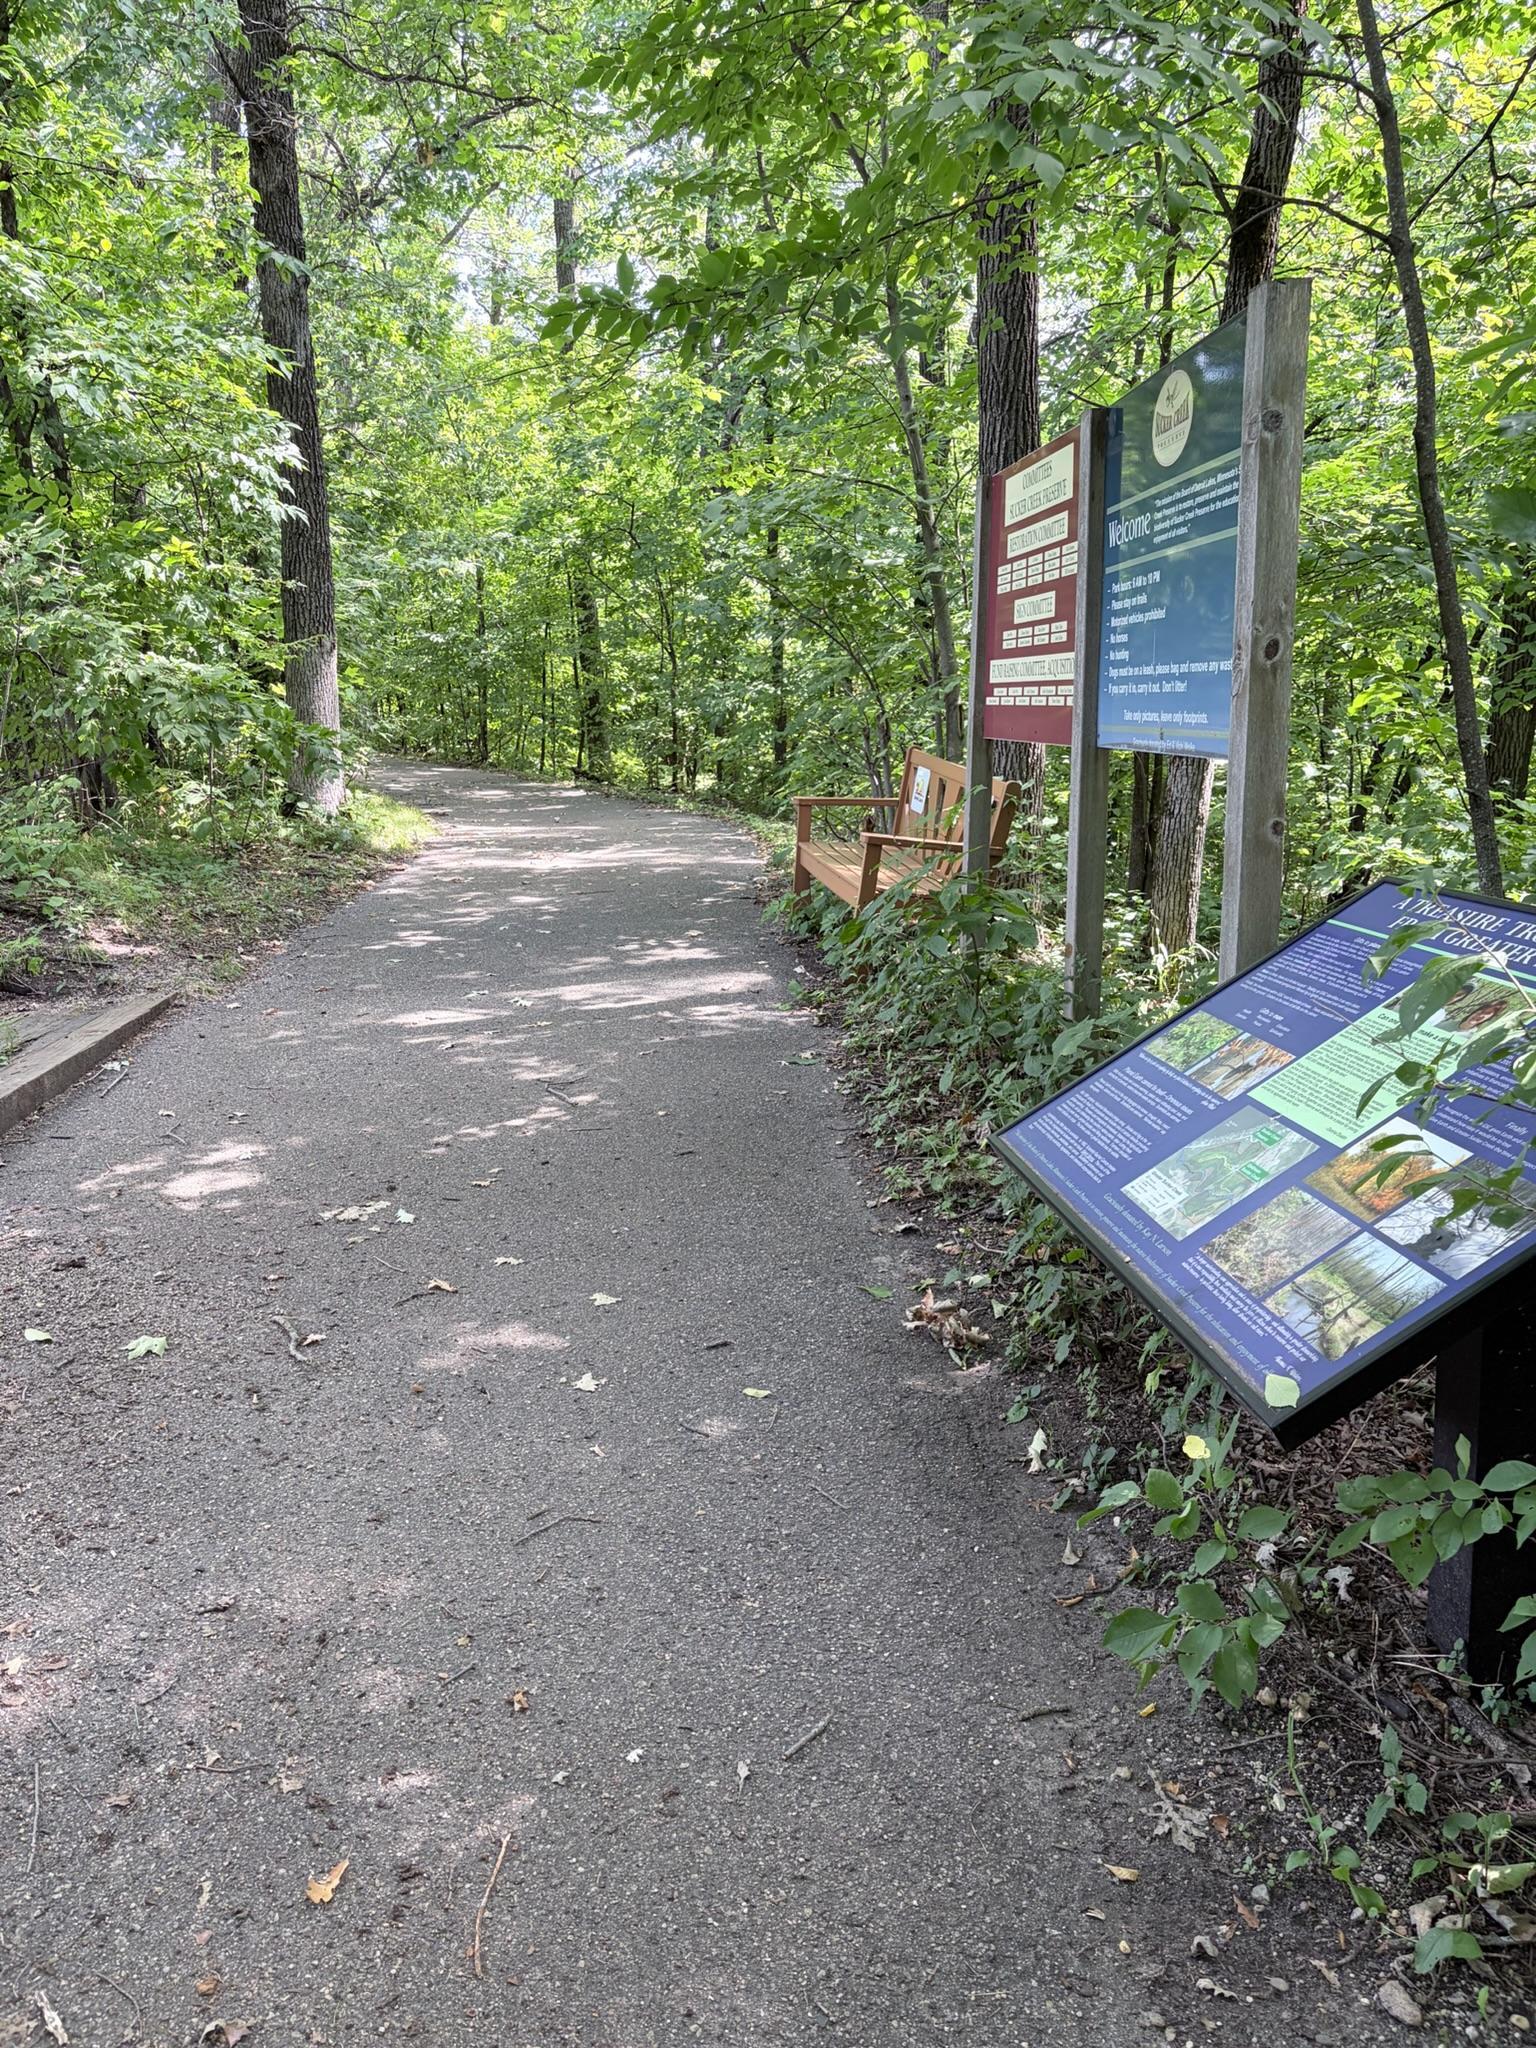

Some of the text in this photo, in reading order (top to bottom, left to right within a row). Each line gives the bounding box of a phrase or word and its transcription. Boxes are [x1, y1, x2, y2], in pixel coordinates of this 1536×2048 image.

[1023, 460, 1052, 489] COMMITTEES
[1010, 479, 1066, 519] SUCKER CREEK PRESERVE
[1010, 518, 1064, 552] RESTORATION COMMITTEE
[1109, 513, 1150, 546] Welcome
[1112, 582, 1120, 593] Park
[1136, 576, 1142, 587] AM
[1142, 576, 1147, 586] to
[1153, 571, 1160, 582] PM
[1027, 596, 1052, 616] COMMITTEE
[1112, 593, 1147, 610] Please stay on trails
[1111, 607, 1166, 627] Motorized vehicles prohibited
[1110, 634, 1128, 643] No horses
[1110, 649, 1128, 661] No hunting
[1109, 667, 1118, 679] Dogs
[1118, 667, 1128, 676] must
[1128, 666, 1133, 676] be
[1134, 667, 1138, 675] on
[1156, 663, 1169, 676] please
[1170, 662, 1179, 676] bag
[1180, 661, 1188, 673] and
[1190, 662, 1208, 672] remove
[1209, 662, 1219, 674] any
[1119, 685, 1128, 696] carry
[1137, 684, 1147, 695] carry
[1162, 681, 1174, 692] Don't
[1175, 680, 1187, 691] litter!
[1124, 710, 1132, 720] Take
[1133, 711, 1141, 723] only
[1161, 711, 1172, 721] leave
[1173, 711, 1182, 725] only
[1392, 897, 1413, 910] A
[1407, 898, 1511, 932] TREASURE
[1443, 928, 1536, 965] GREATER
[1506, 1122, 1528, 1135] Finally
